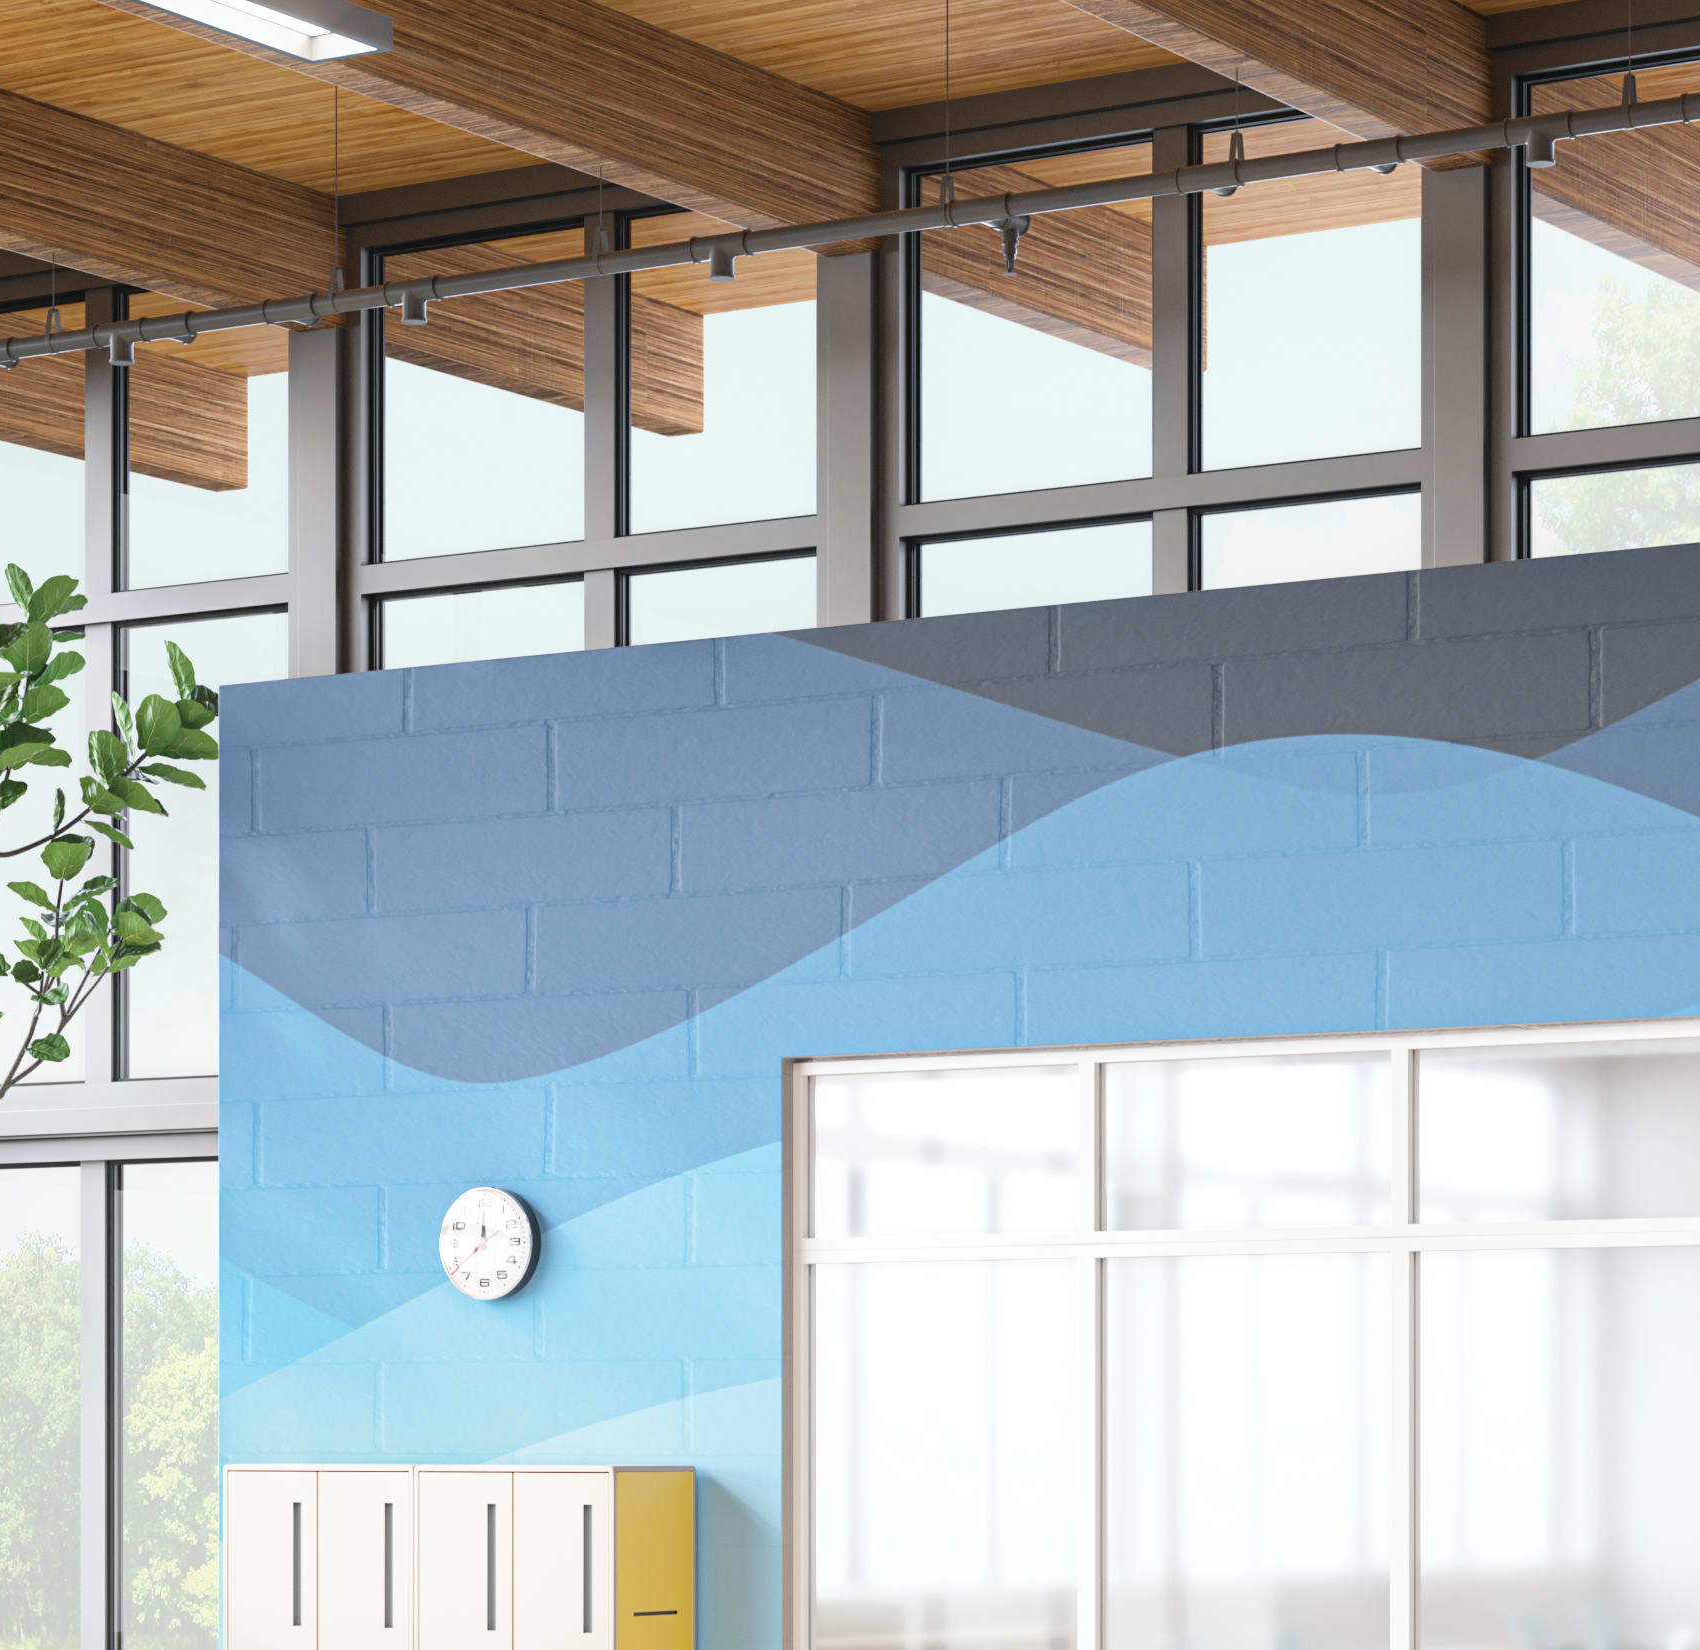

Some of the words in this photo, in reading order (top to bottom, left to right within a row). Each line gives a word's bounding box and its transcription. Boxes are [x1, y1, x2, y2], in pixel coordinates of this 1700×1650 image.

[452, 1221, 466, 1232] 10
[505, 1220, 517, 1229] 2
[509, 1237, 521, 1246] 3
[506, 1255, 517, 1265] 4
[461, 1271, 471, 1281] 7
[496, 1270, 508, 1279] 5
[479, 1278, 490, 1288] 6
